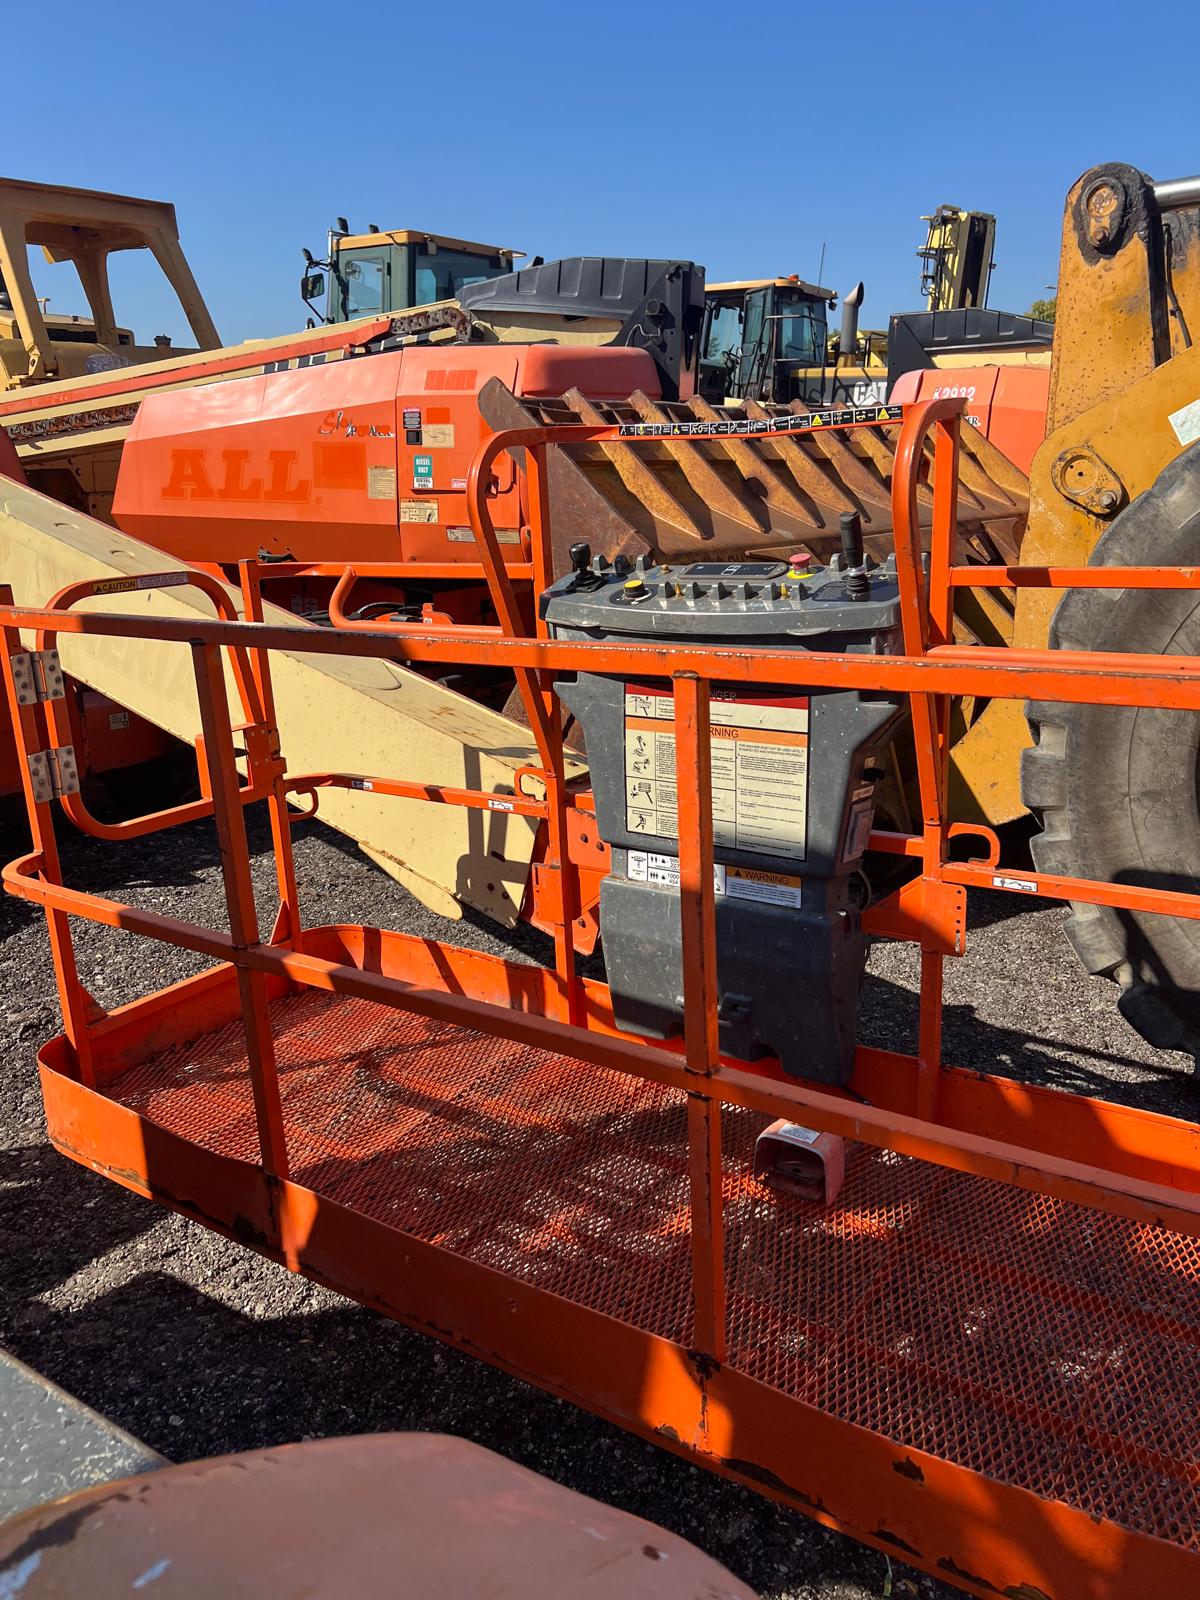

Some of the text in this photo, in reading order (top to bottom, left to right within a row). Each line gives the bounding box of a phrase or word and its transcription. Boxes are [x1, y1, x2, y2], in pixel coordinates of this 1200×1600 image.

[853, 381, 888, 406] CAT
[415, 458, 431, 466] DIESEL
[161, 449, 312, 504] ALL
[102, 580, 136, 592] CAUTION
[708, 689, 737, 702] NGER
[709, 726, 739, 738] RNING
[743, 870, 790, 885] WARNING
